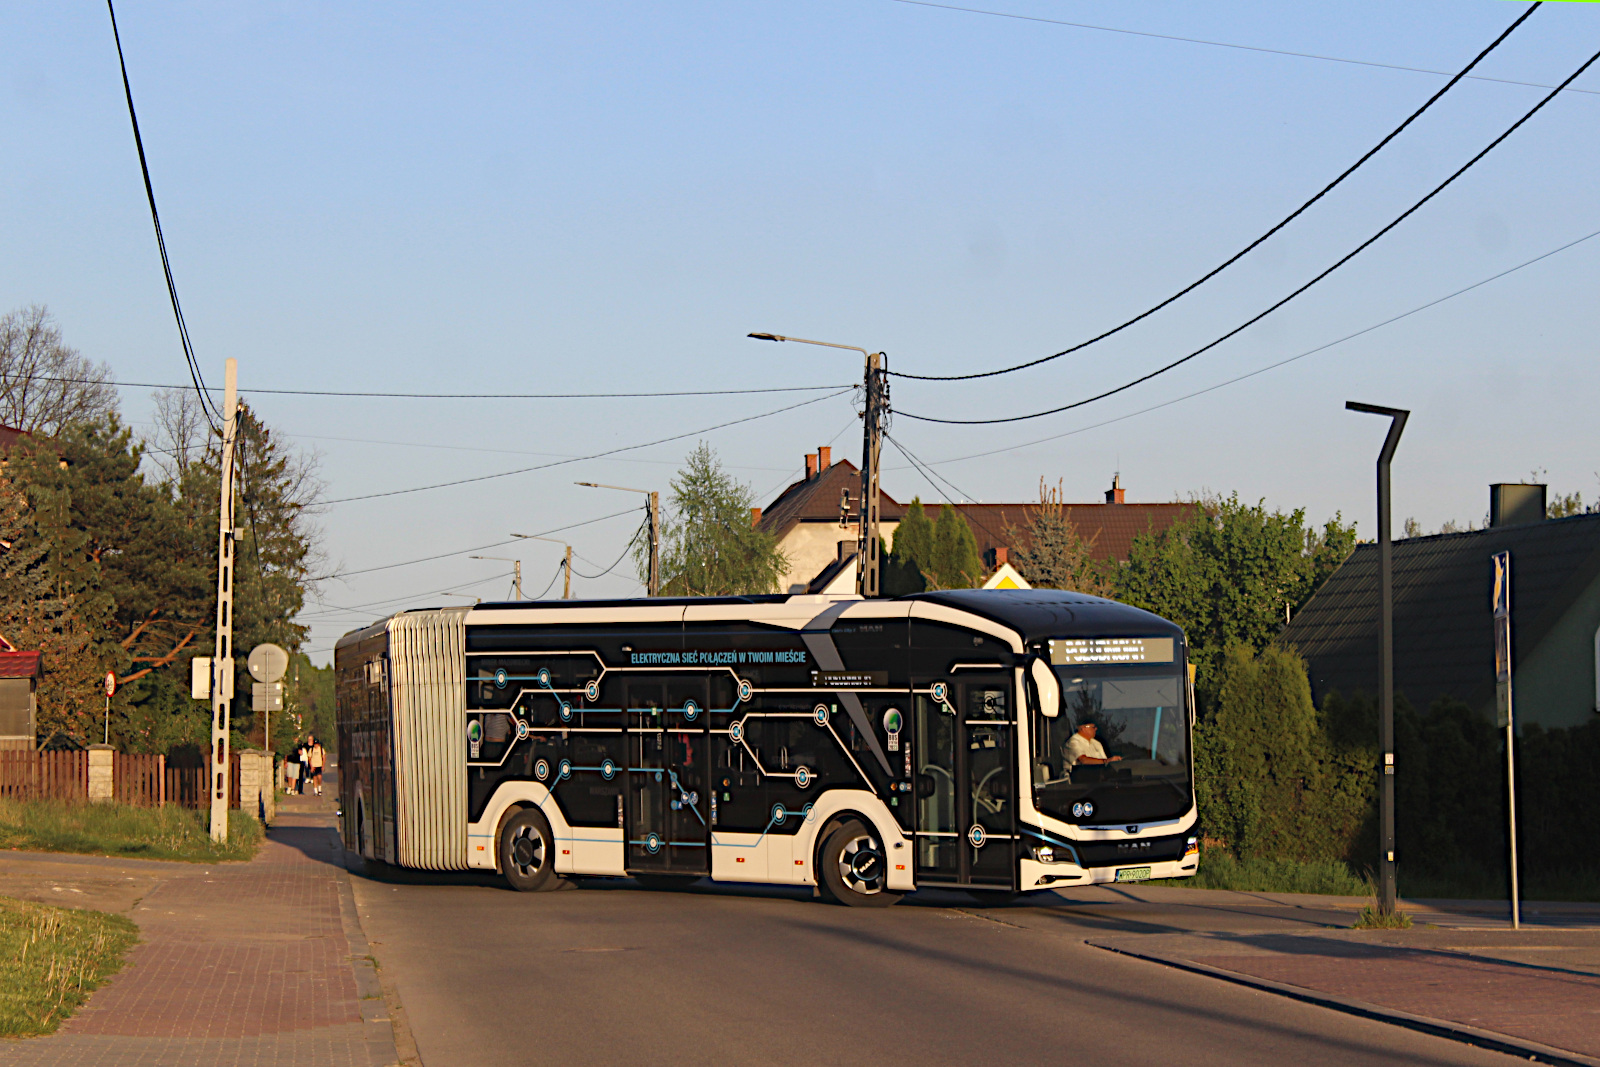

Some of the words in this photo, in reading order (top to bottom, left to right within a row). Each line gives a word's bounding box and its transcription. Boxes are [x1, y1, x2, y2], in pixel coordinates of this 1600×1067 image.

[859, 624, 883, 632] MAN
[631, 652, 680, 664] ELEKTRYCZNA
[681, 649, 698, 664] SIEĆ
[700, 649, 737, 666] POŁĄCZEŃ
[738, 651, 746, 663] W
[747, 651, 774, 663] TWOIM
[775, 649, 806, 663] MIEŚCIE
[1117, 841, 1151, 853] MAN
